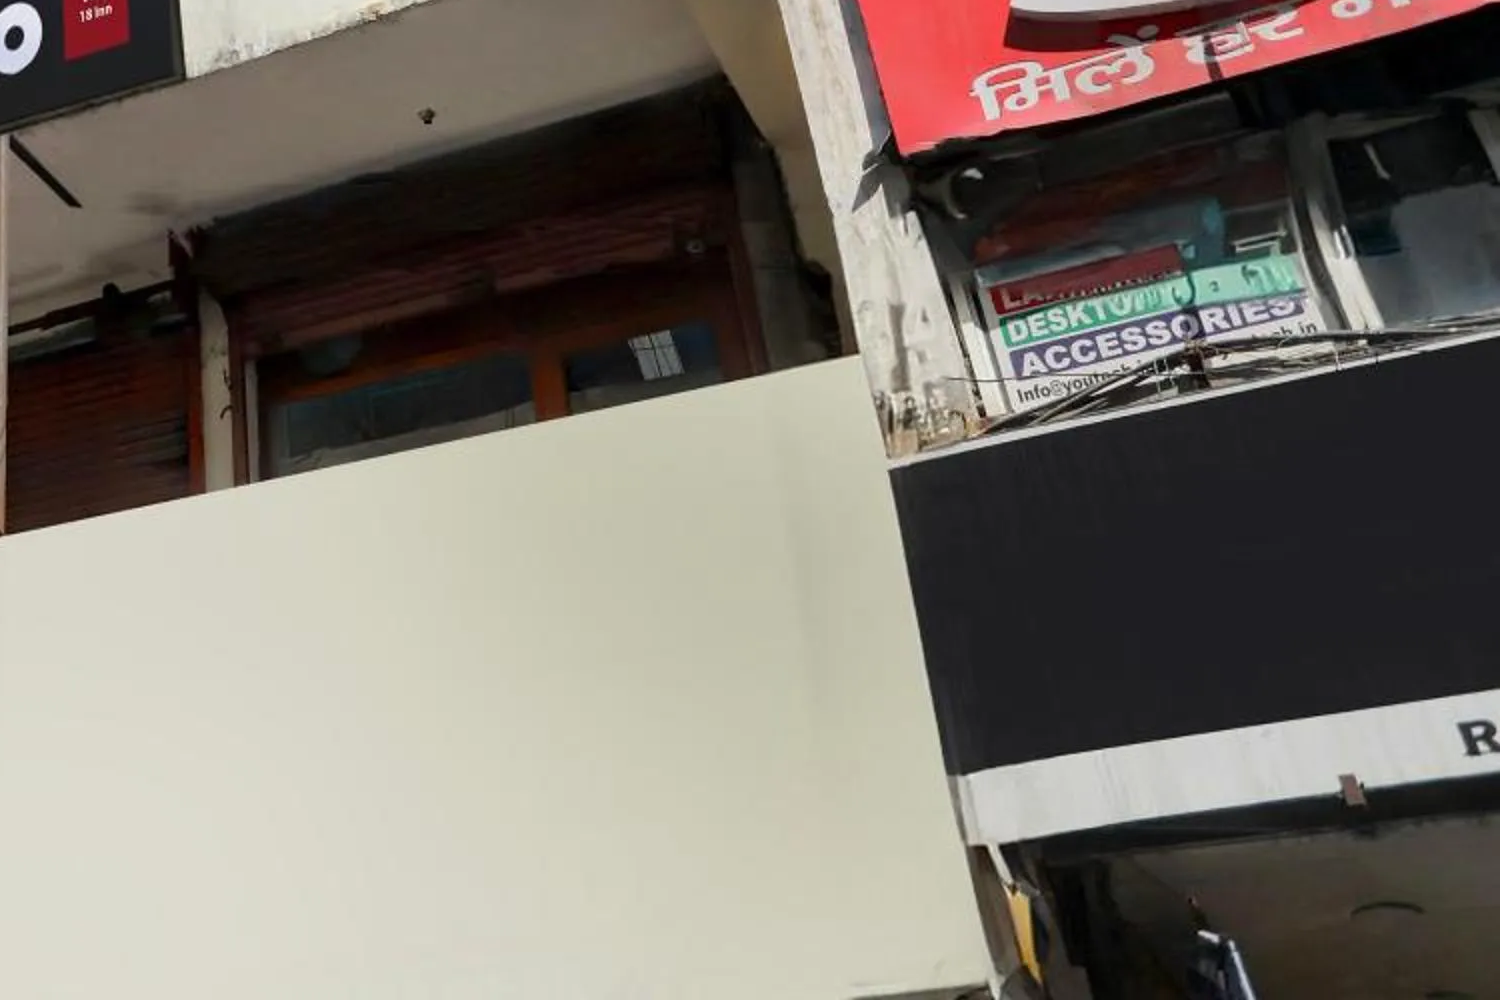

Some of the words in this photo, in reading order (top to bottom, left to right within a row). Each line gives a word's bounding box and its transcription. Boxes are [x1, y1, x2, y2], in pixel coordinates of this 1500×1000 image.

[79, 8, 92, 23] 18
[969, 22, 1160, 121] मिलें
[1021, 298, 1297, 377] ACCESSORIES
